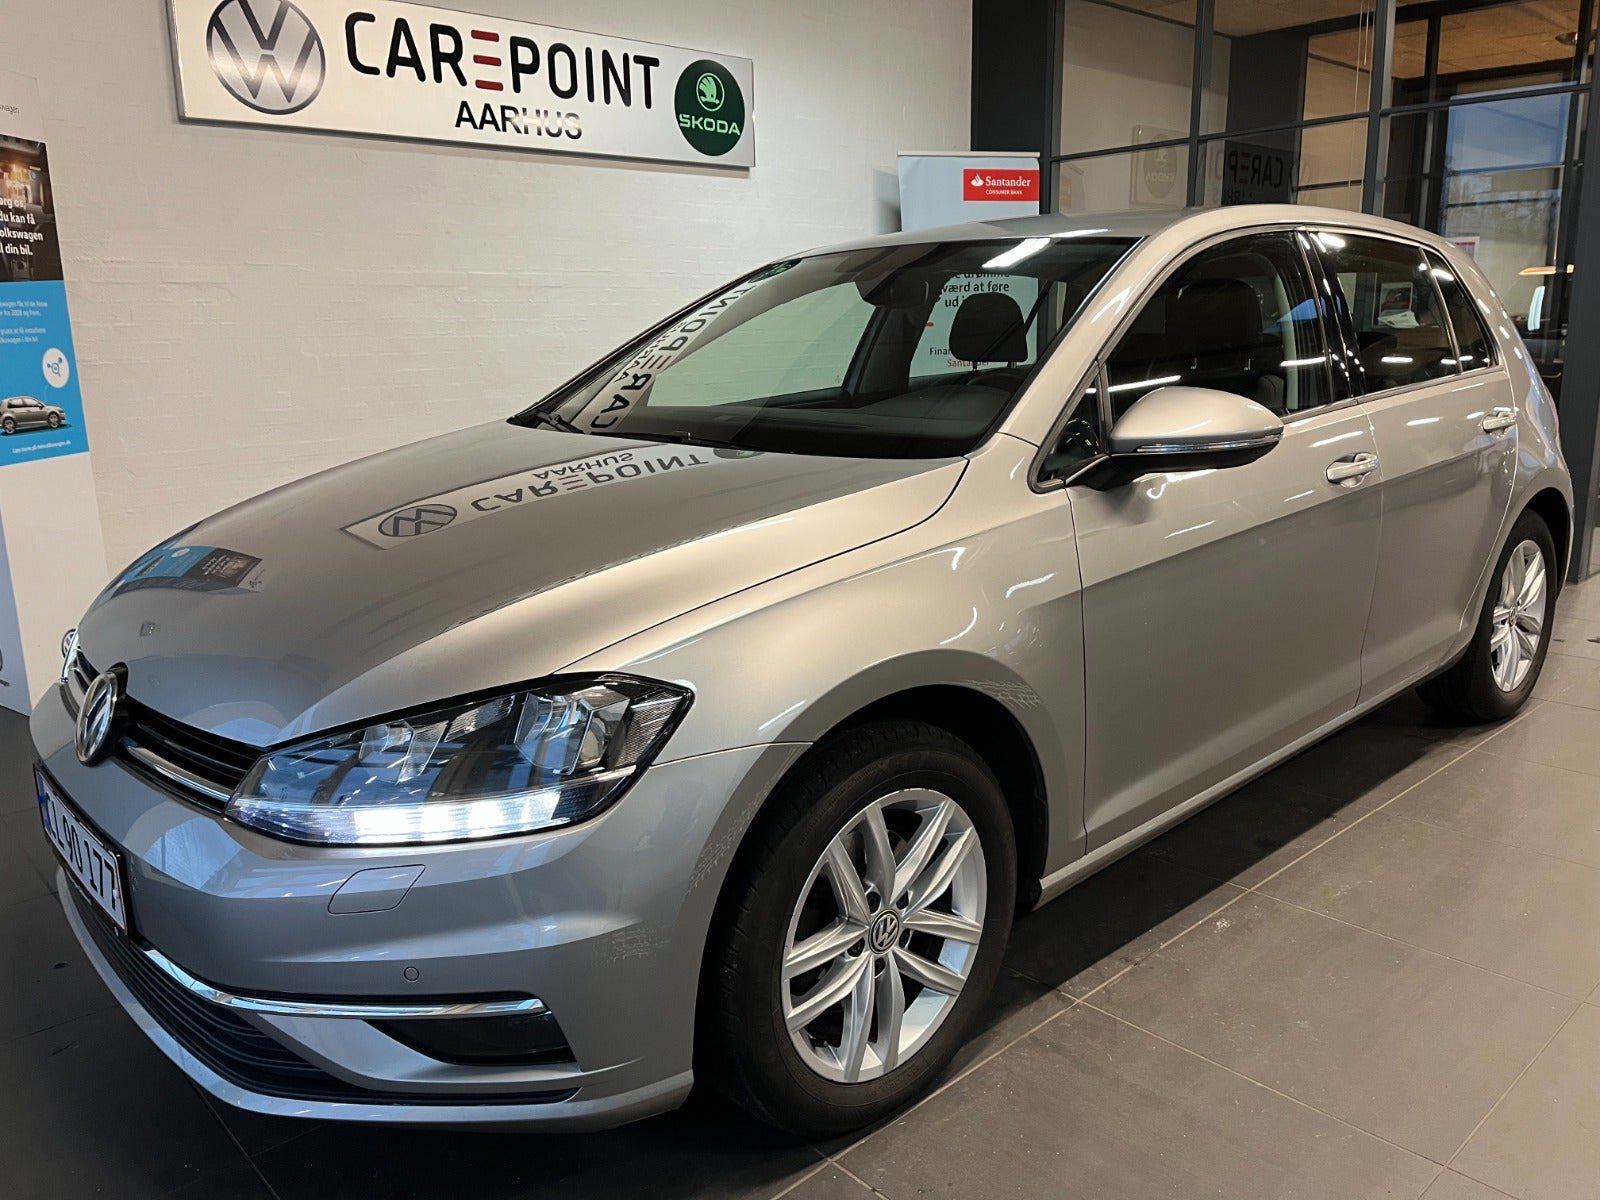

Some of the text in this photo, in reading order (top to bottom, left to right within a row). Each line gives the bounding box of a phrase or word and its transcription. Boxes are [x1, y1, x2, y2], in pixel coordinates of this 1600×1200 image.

[345, 11, 660, 110] CAREPOINT
[455, 100, 583, 140] AARHUS
[985, 175, 1032, 187] Santander
[10, 212, 26, 223] kan
[5, 243, 19, 255] din
[943, 280, 1010, 292] værd at føre
[944, 296, 959, 307] ud
[62, 814, 84, 875] 90
[84, 840, 116, 911] 177
